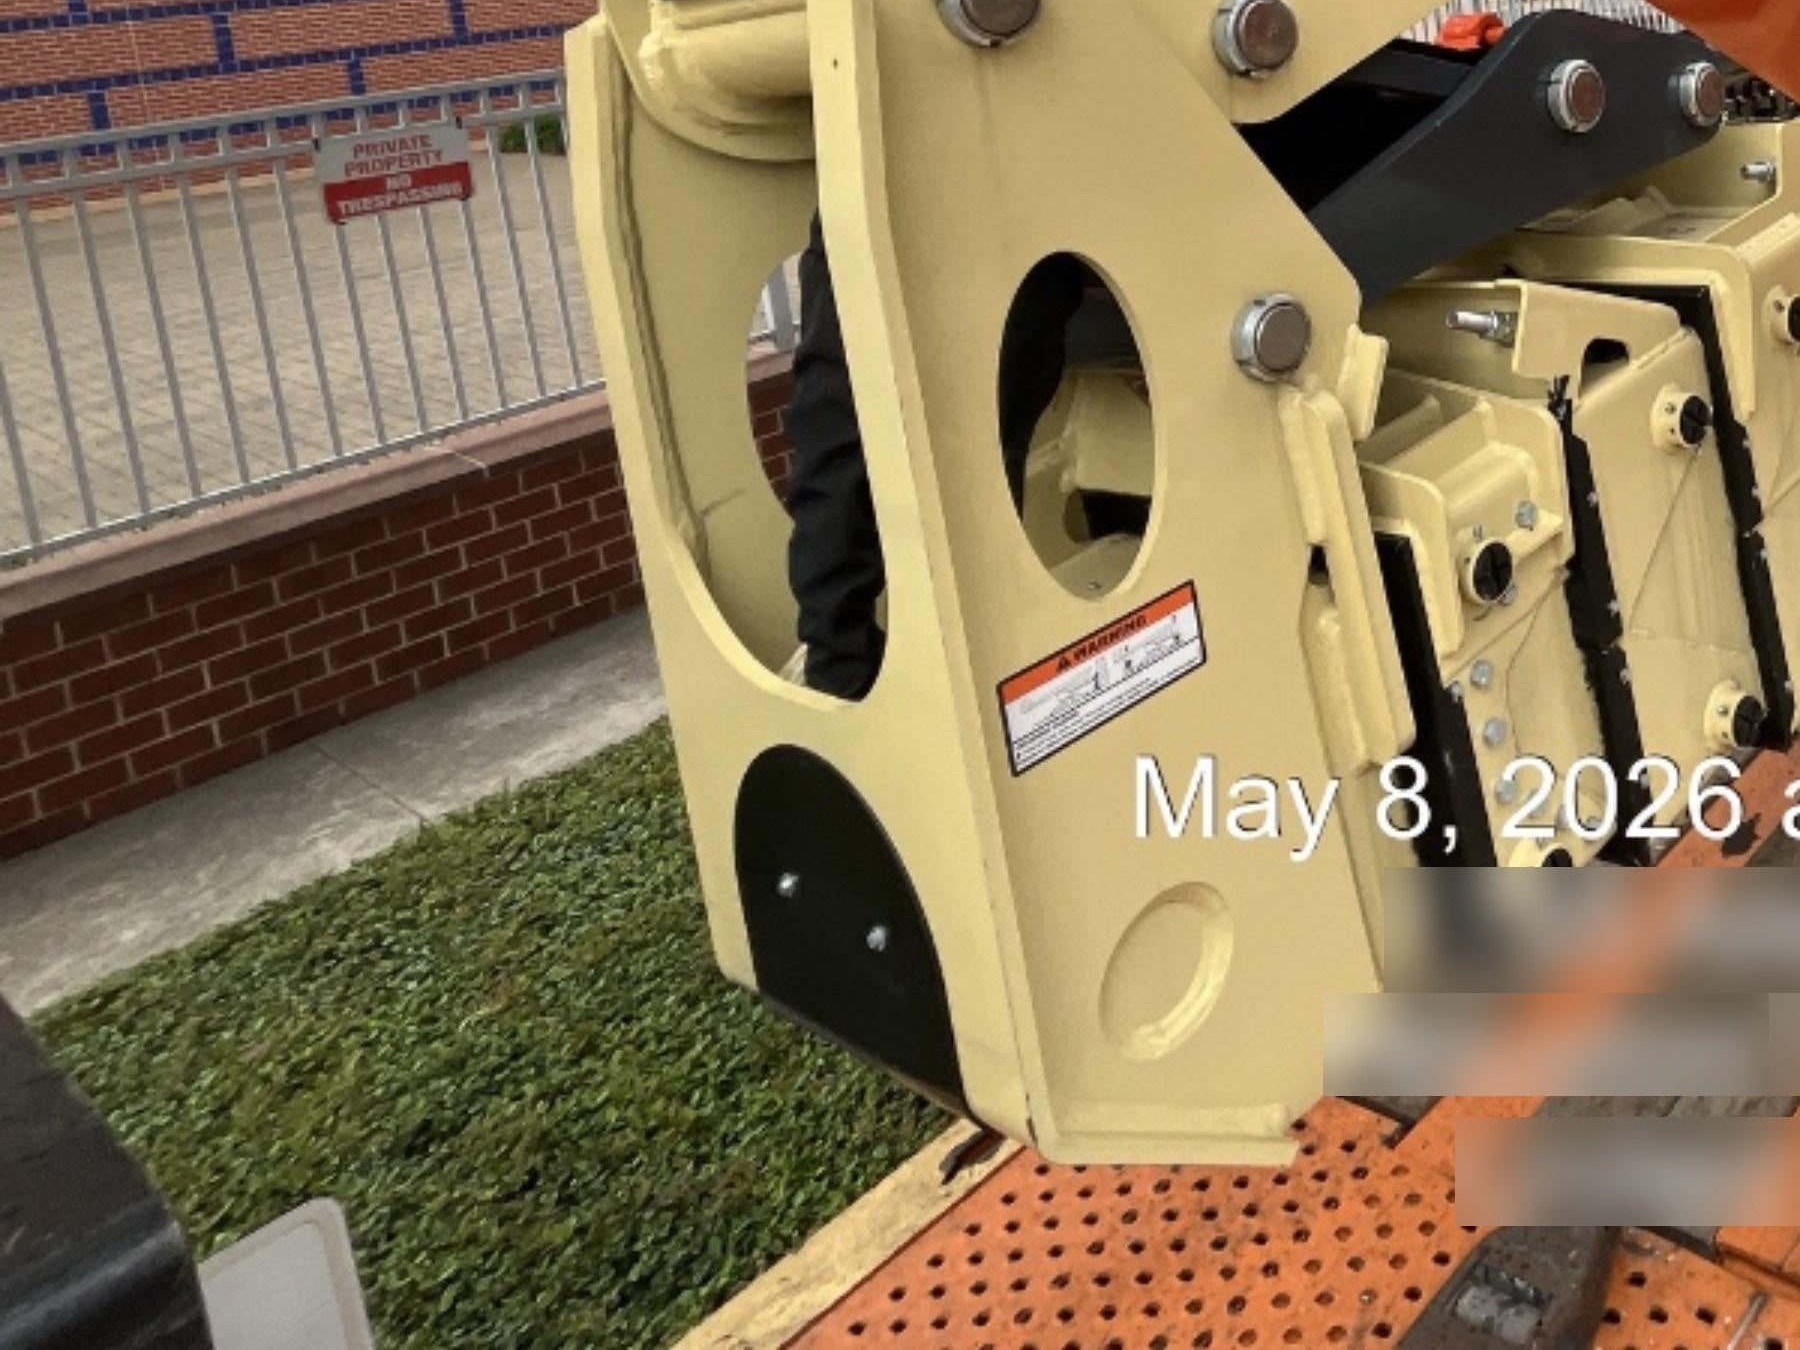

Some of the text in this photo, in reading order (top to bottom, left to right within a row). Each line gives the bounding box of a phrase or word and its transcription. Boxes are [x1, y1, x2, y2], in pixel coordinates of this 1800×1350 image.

[353, 134, 432, 159] PRIVATE
[344, 150, 443, 177] PROPERTY
[385, 174, 412, 191] NO
[336, 182, 463, 214] TRESPASSING
[1072, 614, 1147, 662] WARNING
